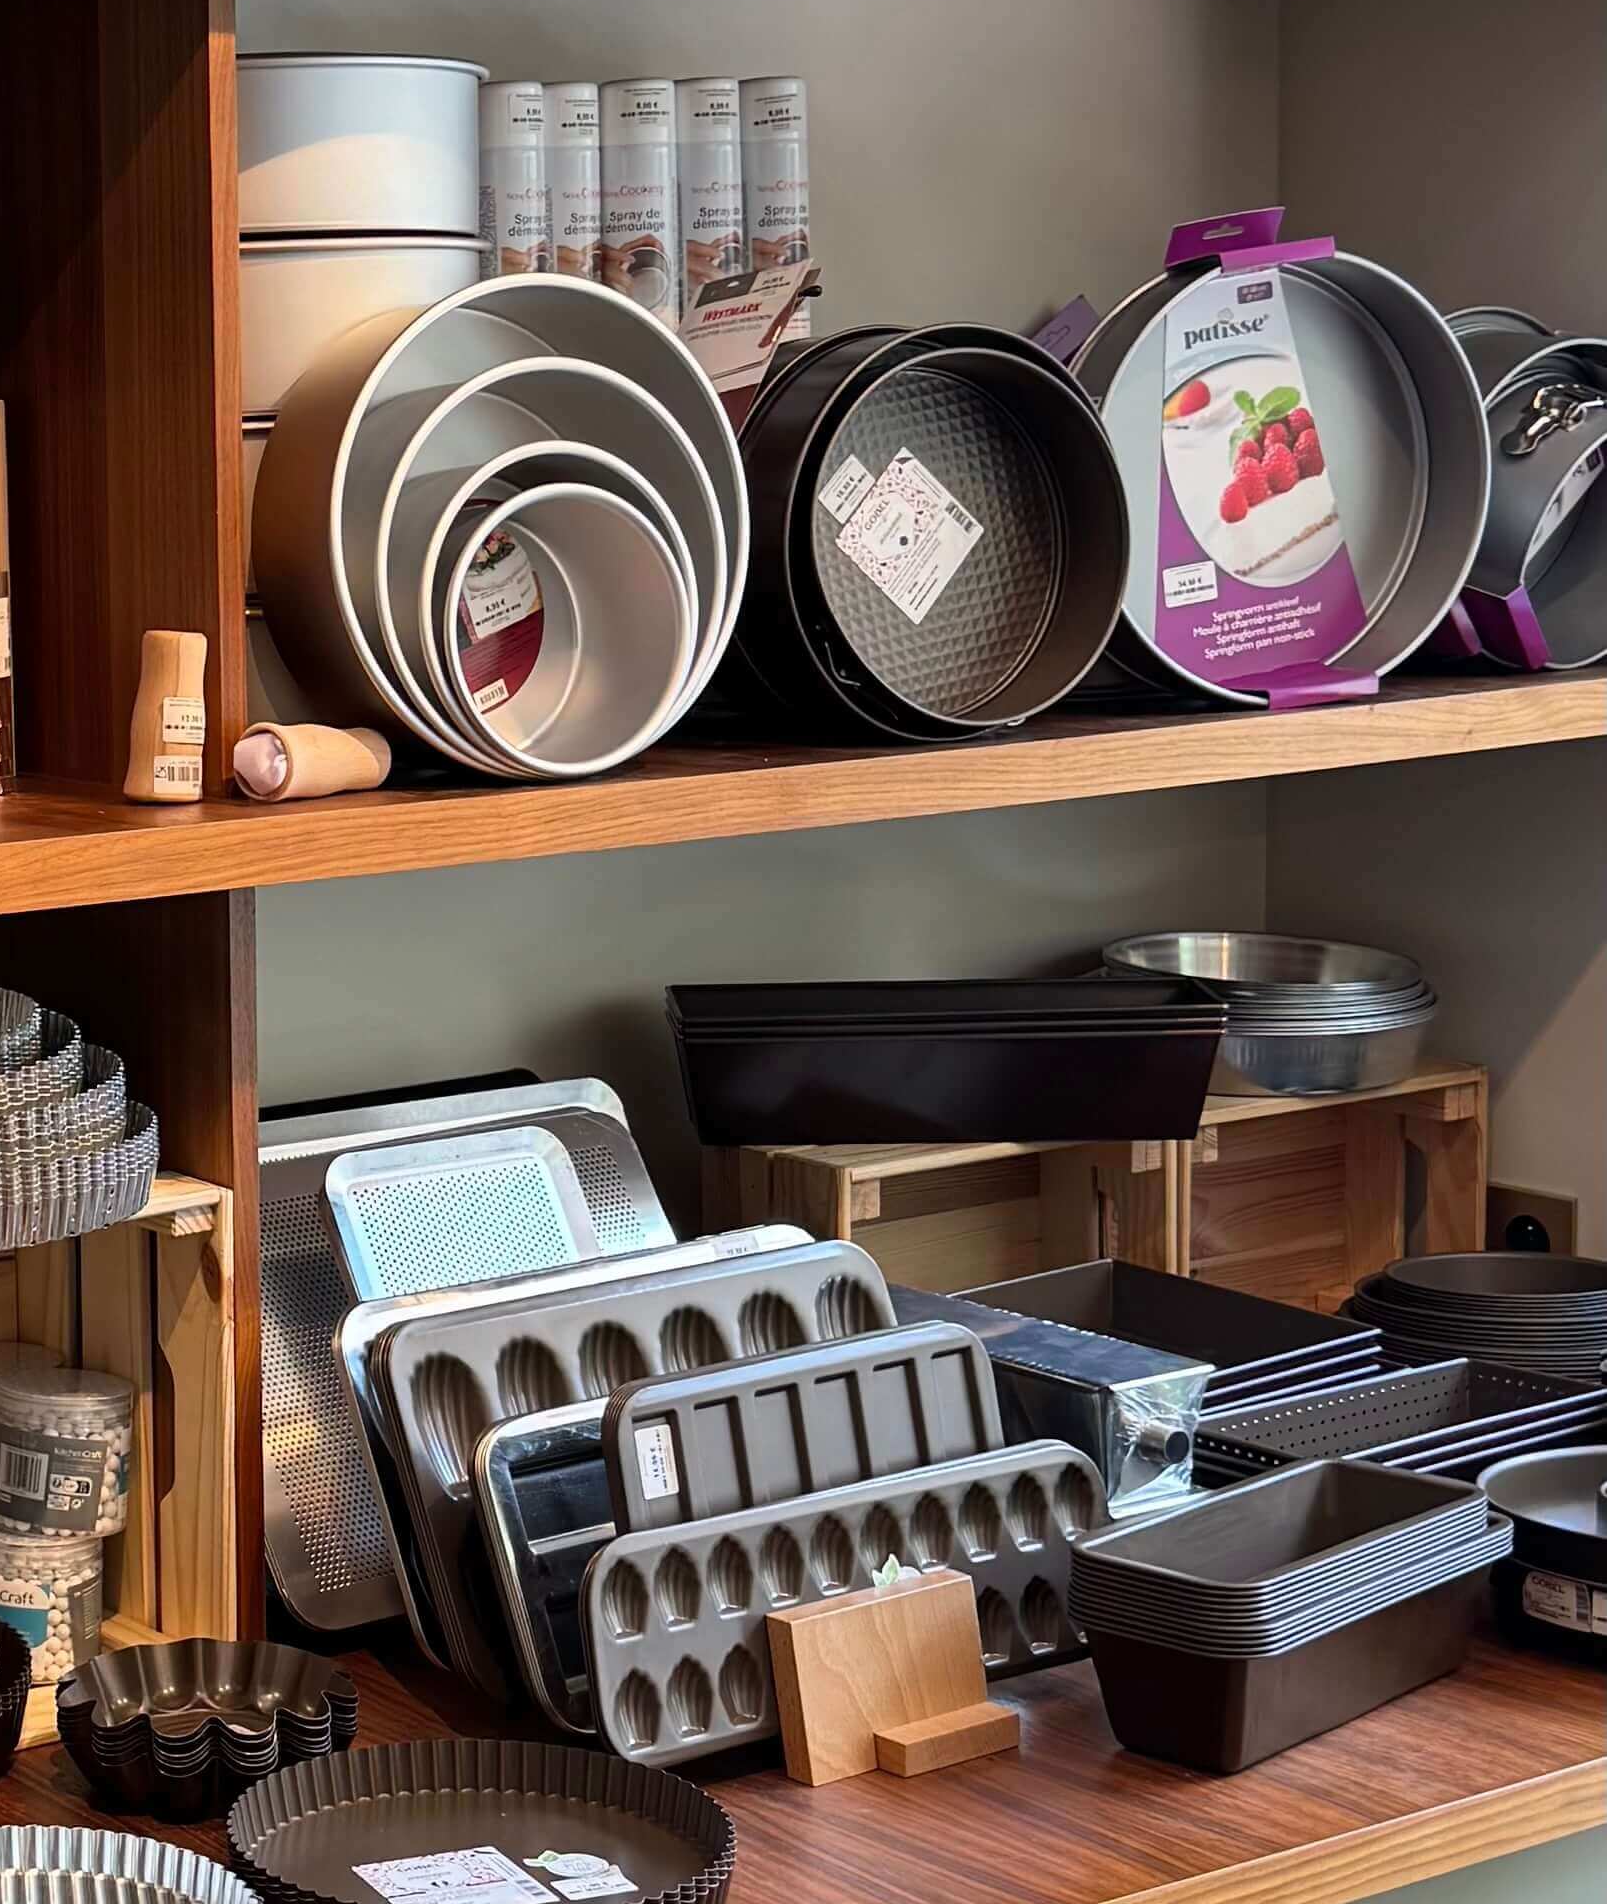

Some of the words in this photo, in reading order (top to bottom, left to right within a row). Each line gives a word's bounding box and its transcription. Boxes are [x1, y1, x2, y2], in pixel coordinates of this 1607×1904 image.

[610, 210, 642, 223] Spray
[646, 208, 660, 218] de
[1193, 625, 1221, 637] Moule
